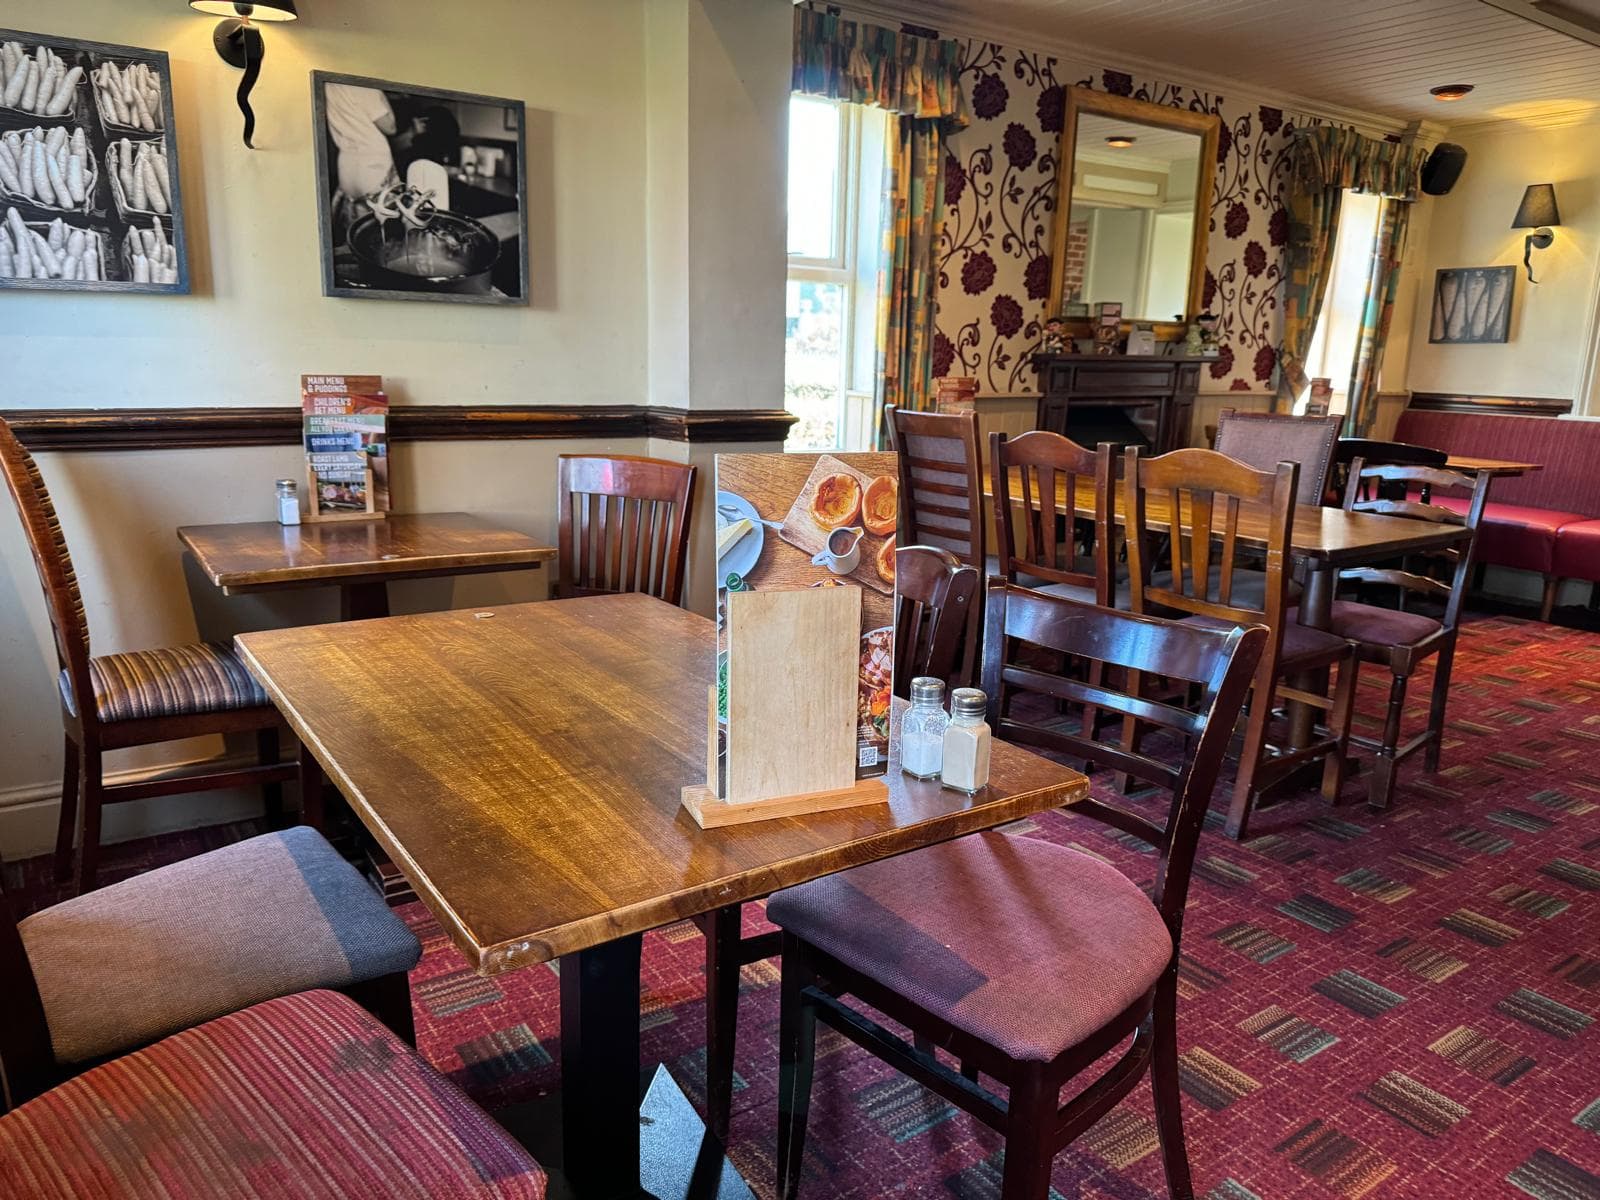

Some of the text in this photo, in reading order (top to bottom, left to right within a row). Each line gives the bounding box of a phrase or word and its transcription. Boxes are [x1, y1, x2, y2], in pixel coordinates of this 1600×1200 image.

[307, 376, 345, 384] MAIN MENU
[307, 384, 348, 393] & PUDDINGS
[314, 397, 352, 406] CHILDREN'S
[327, 406, 346, 415] MENU
[311, 438, 336, 446] DRINKS
